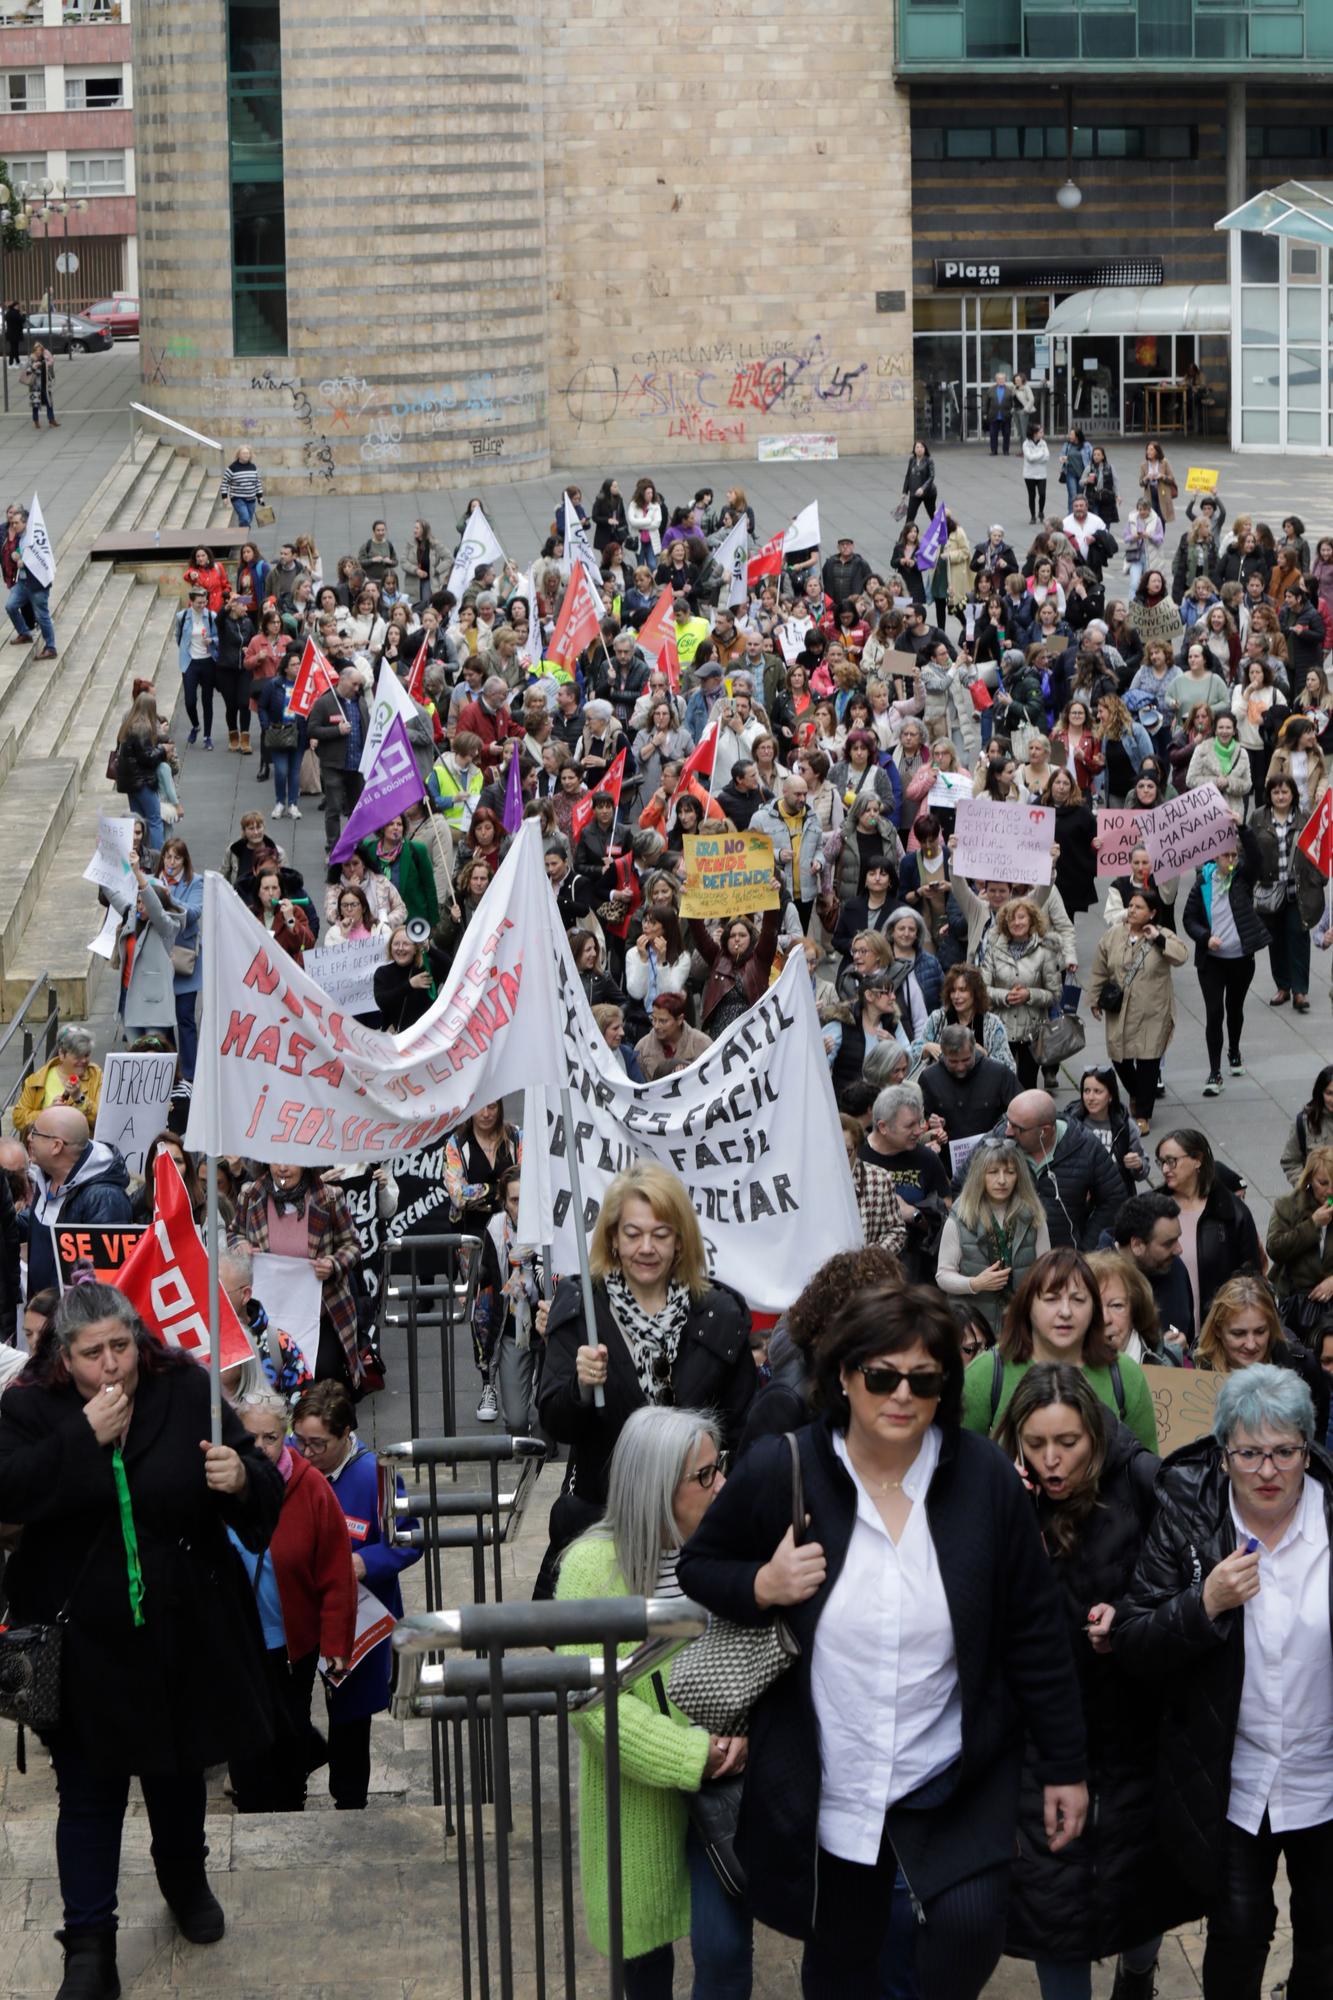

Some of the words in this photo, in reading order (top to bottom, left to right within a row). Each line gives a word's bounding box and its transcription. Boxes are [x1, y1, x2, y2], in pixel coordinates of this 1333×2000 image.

[945, 262, 1000, 278] Plaza
[1135, 813, 1156, 837] HOY
[1162, 787, 1220, 825] PALMADA
[1103, 815, 1125, 831] NO
[1159, 806, 1223, 849] MAÑANA
[724, 838, 745, 854] NO
[1119, 834, 1138, 846] AU
[1153, 858, 1165, 874] LA
[1162, 826, 1236, 868] PUÑALADA
[695, 854, 747, 873] VENDE
[1100, 851, 1131, 866] COB
[703, 868, 773, 890] DEFIENDE
[993, 866, 1039, 882] MAYORES
[106, 1058, 174, 1105] DERECHO
[118, 1115, 135, 1141] A
[60, 1232, 95, 1263] SE
[101, 1233, 143, 1263] VE
